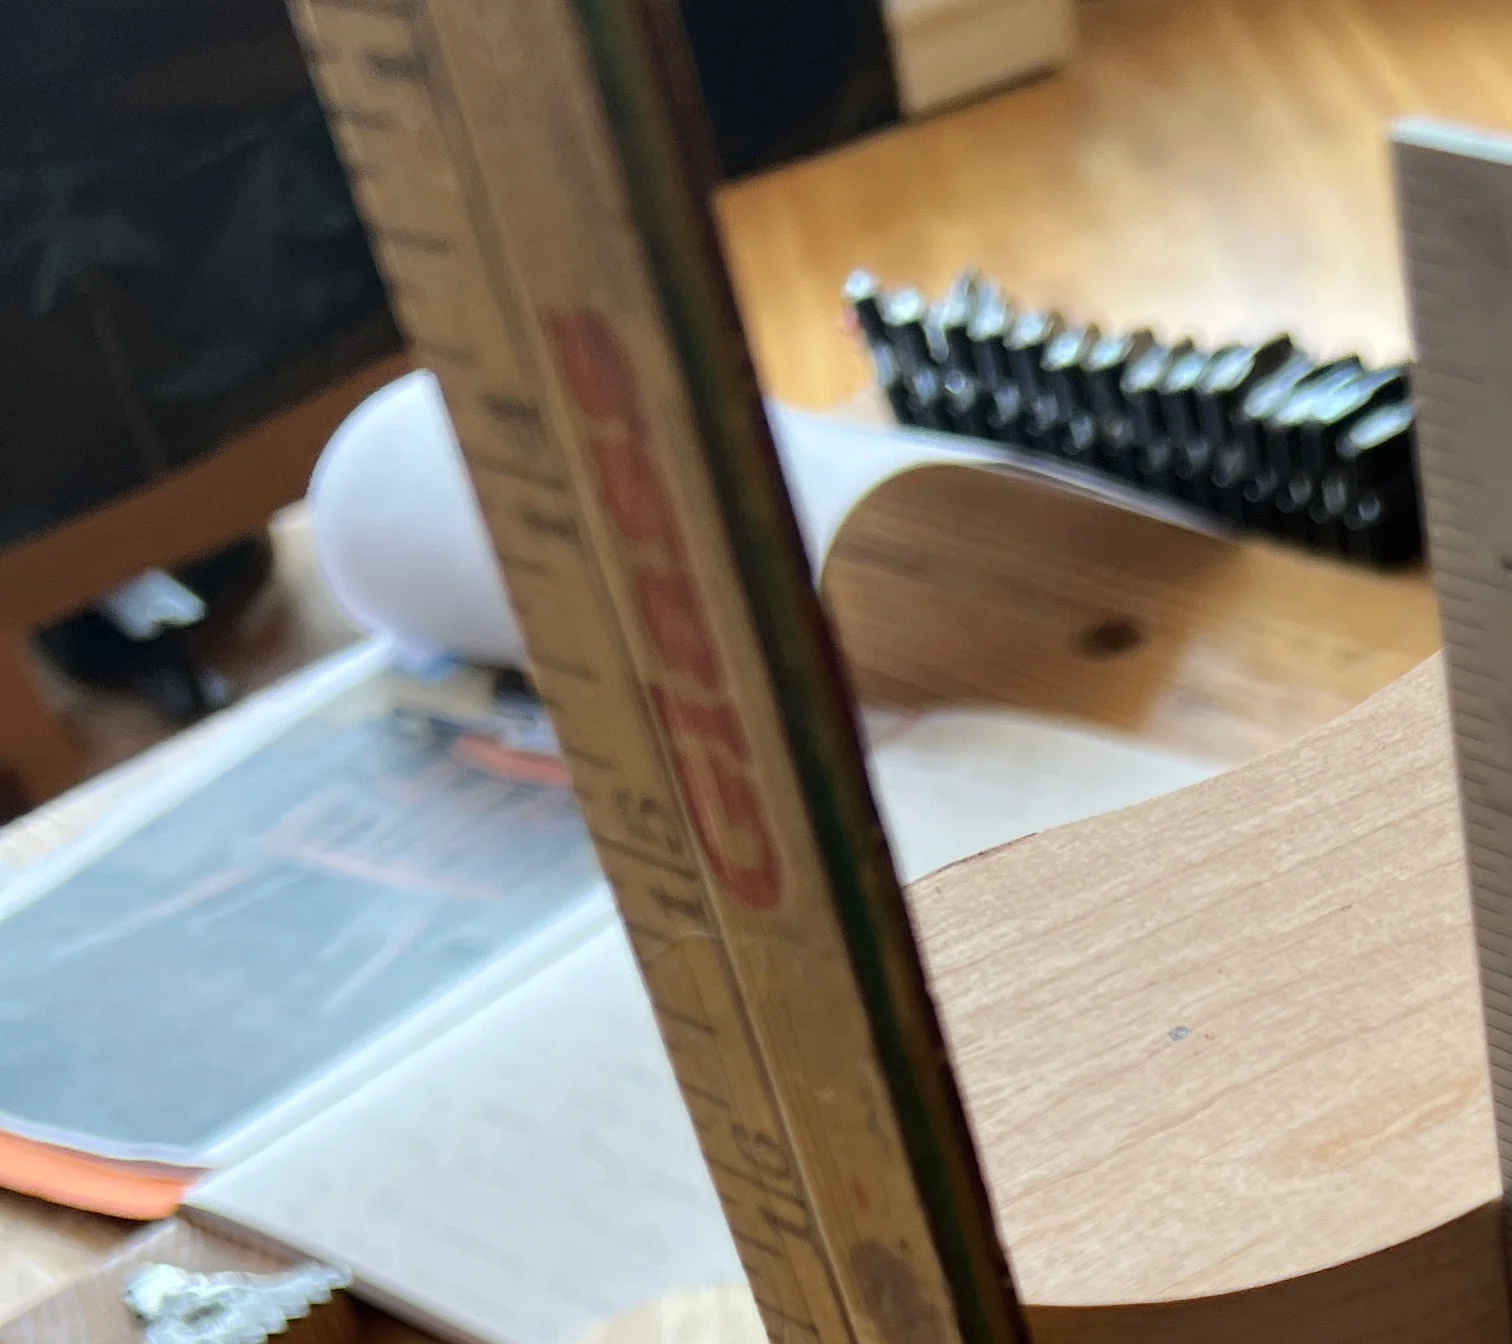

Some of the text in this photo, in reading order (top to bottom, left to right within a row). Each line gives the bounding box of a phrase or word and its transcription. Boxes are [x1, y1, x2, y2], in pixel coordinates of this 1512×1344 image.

[541, 305, 782, 910] Glass
[620, 792, 707, 928] 15
[729, 1120, 812, 1240] 16
